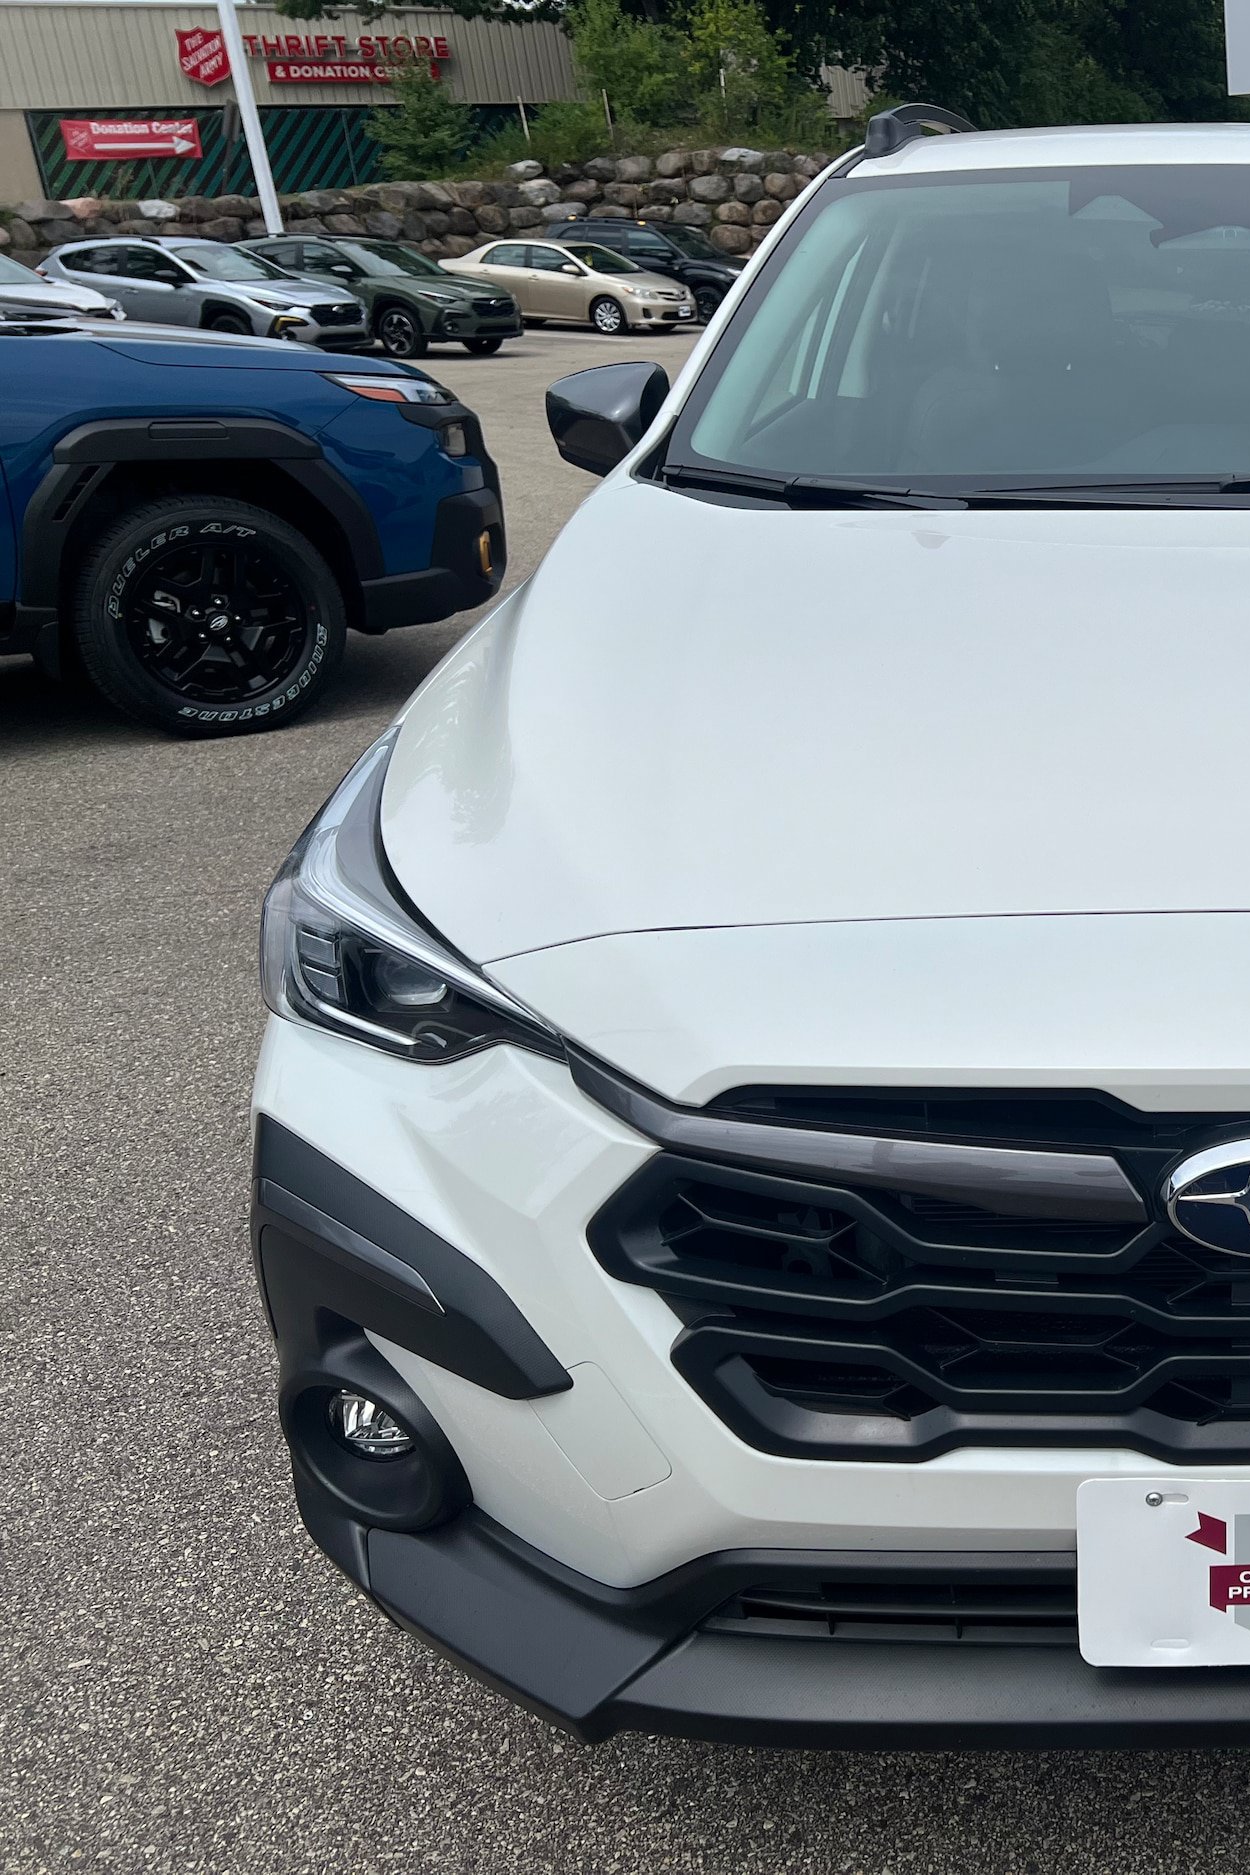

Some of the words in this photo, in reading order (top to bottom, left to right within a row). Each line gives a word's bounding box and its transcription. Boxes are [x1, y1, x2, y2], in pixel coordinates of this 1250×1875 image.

[242, 35, 346, 57] THRIFT
[357, 36, 450, 58] STORE
[274, 66, 286, 78] &
[289, 65, 370, 78] DONATION
[89, 121, 150, 134] Donation
[151, 121, 193, 134] Center
[107, 525, 190, 620] DUELER
[200, 523, 256, 537] A/T
[177, 622, 329, 722] BRIDGESTONE
